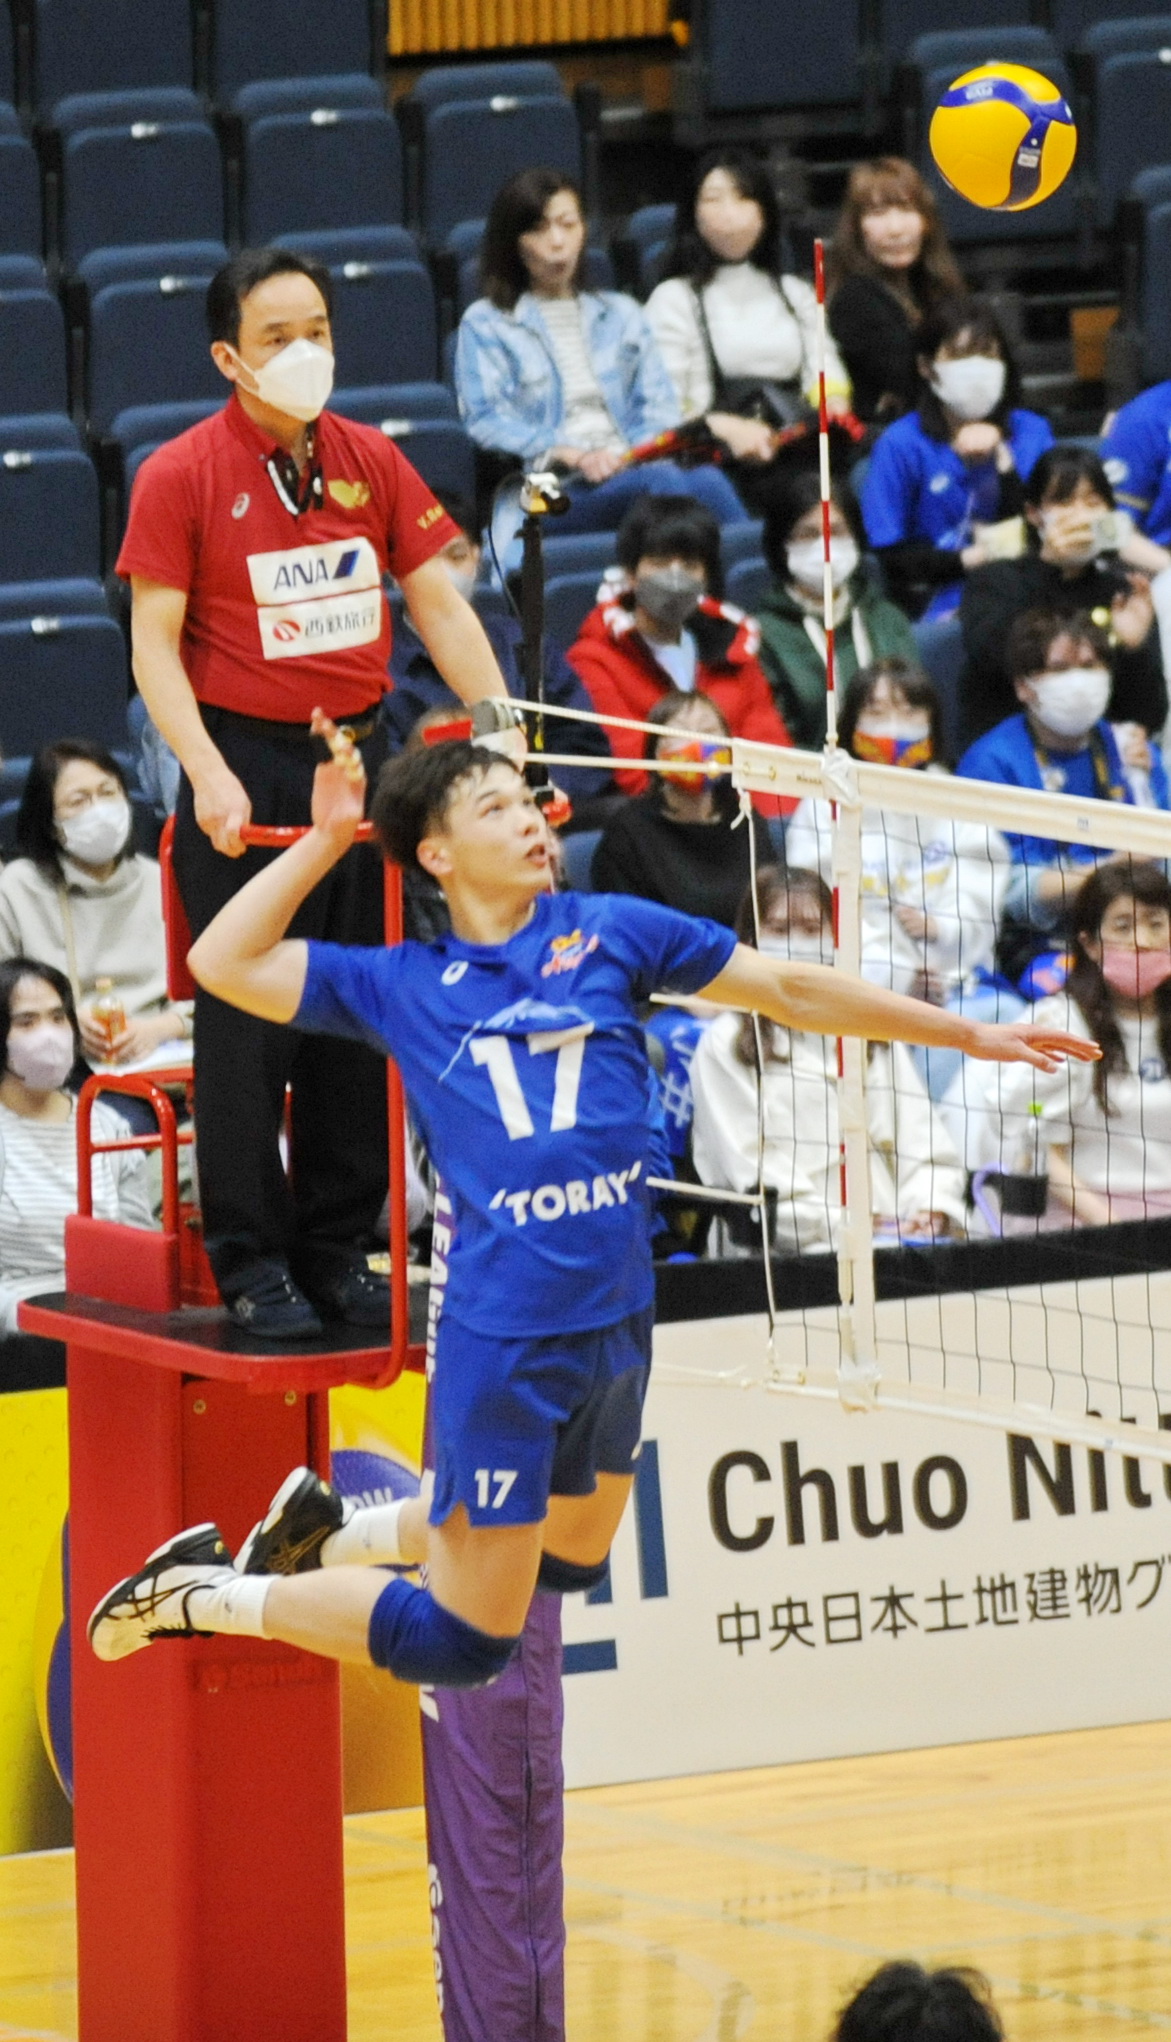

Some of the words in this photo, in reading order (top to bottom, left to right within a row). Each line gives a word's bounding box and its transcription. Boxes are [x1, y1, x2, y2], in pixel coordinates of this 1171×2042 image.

[274, 558, 329, 590] ANA
[305, 607, 375, 637] 西鉄旅行
[468, 1021, 595, 1141] 17
[474, 1469, 518, 1509] 17
[707, 1439, 968, 1553] Chuo
[716, 1554, 1171, 1656] 中央日本土地建物グ
